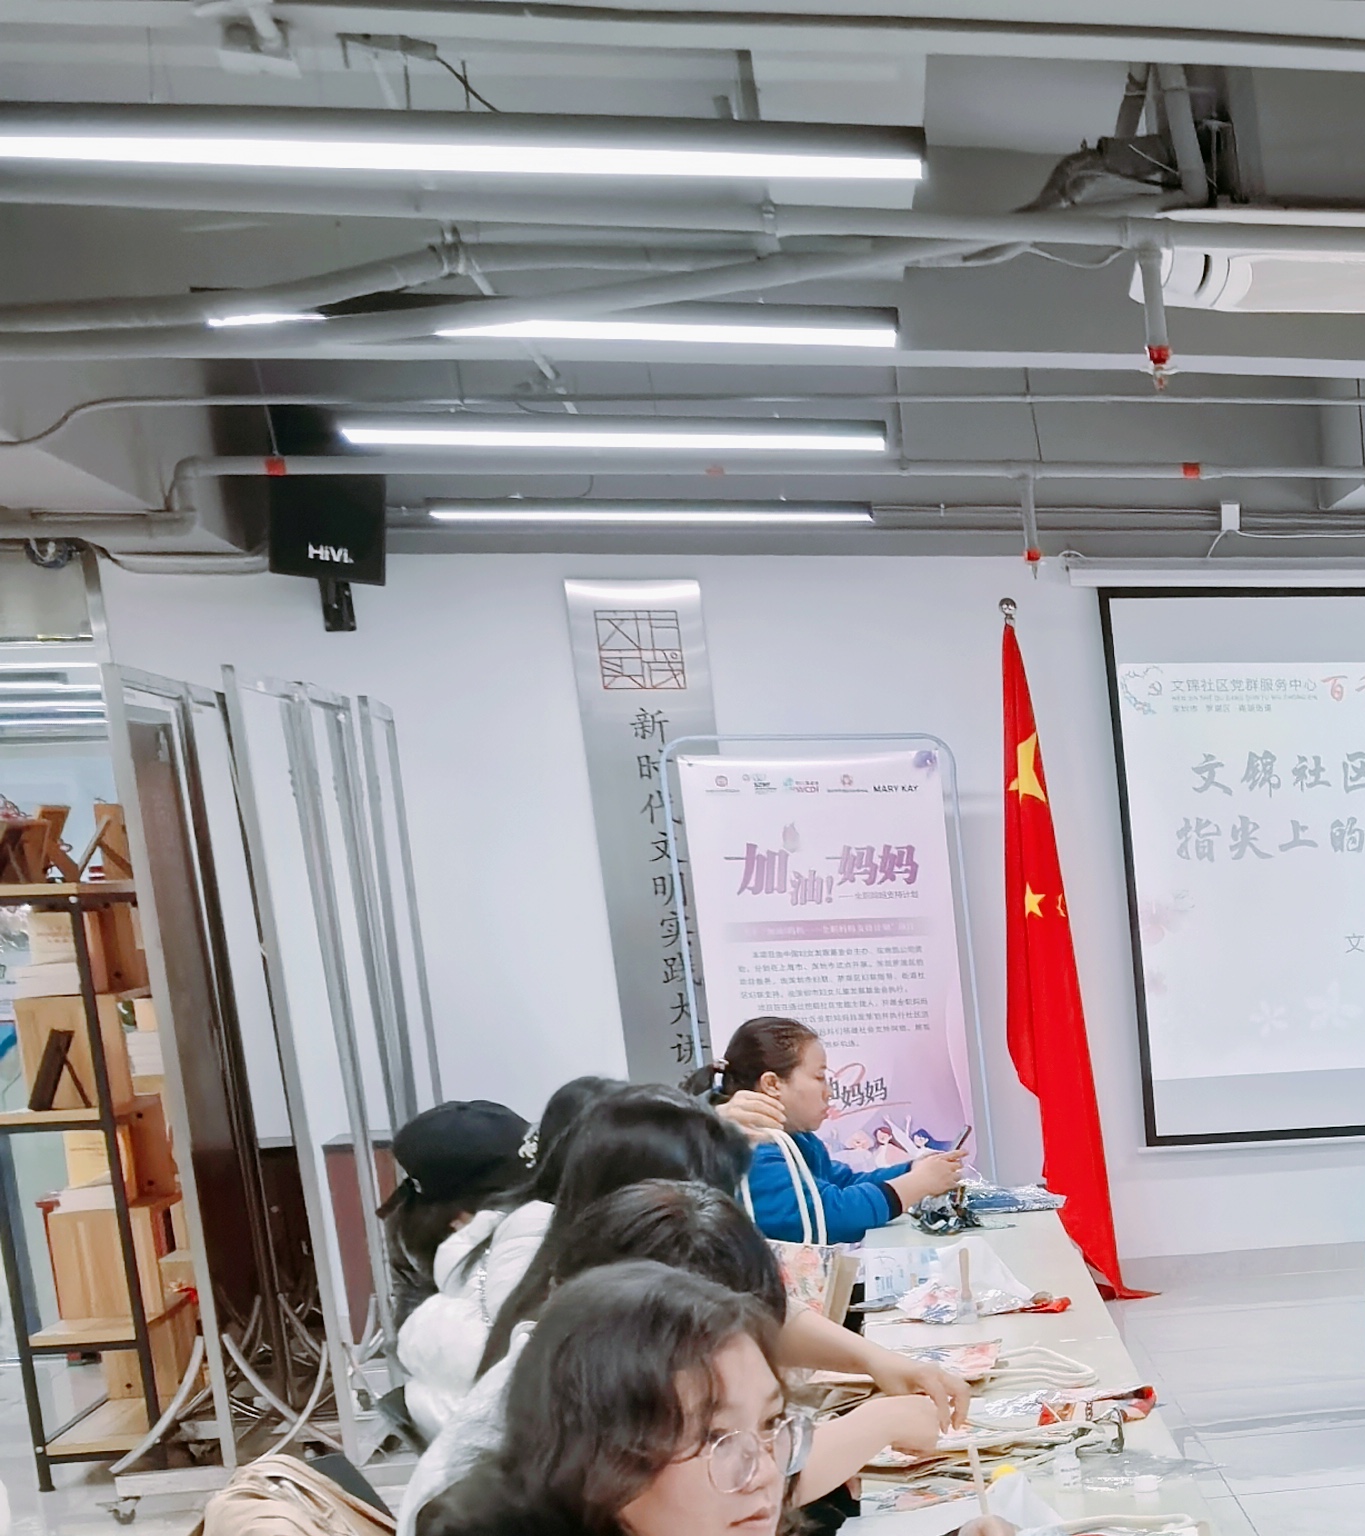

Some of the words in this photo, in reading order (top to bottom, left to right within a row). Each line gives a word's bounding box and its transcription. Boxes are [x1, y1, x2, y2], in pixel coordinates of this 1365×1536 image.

[629, 706, 711, 1085] 新时代文明实践大讲
